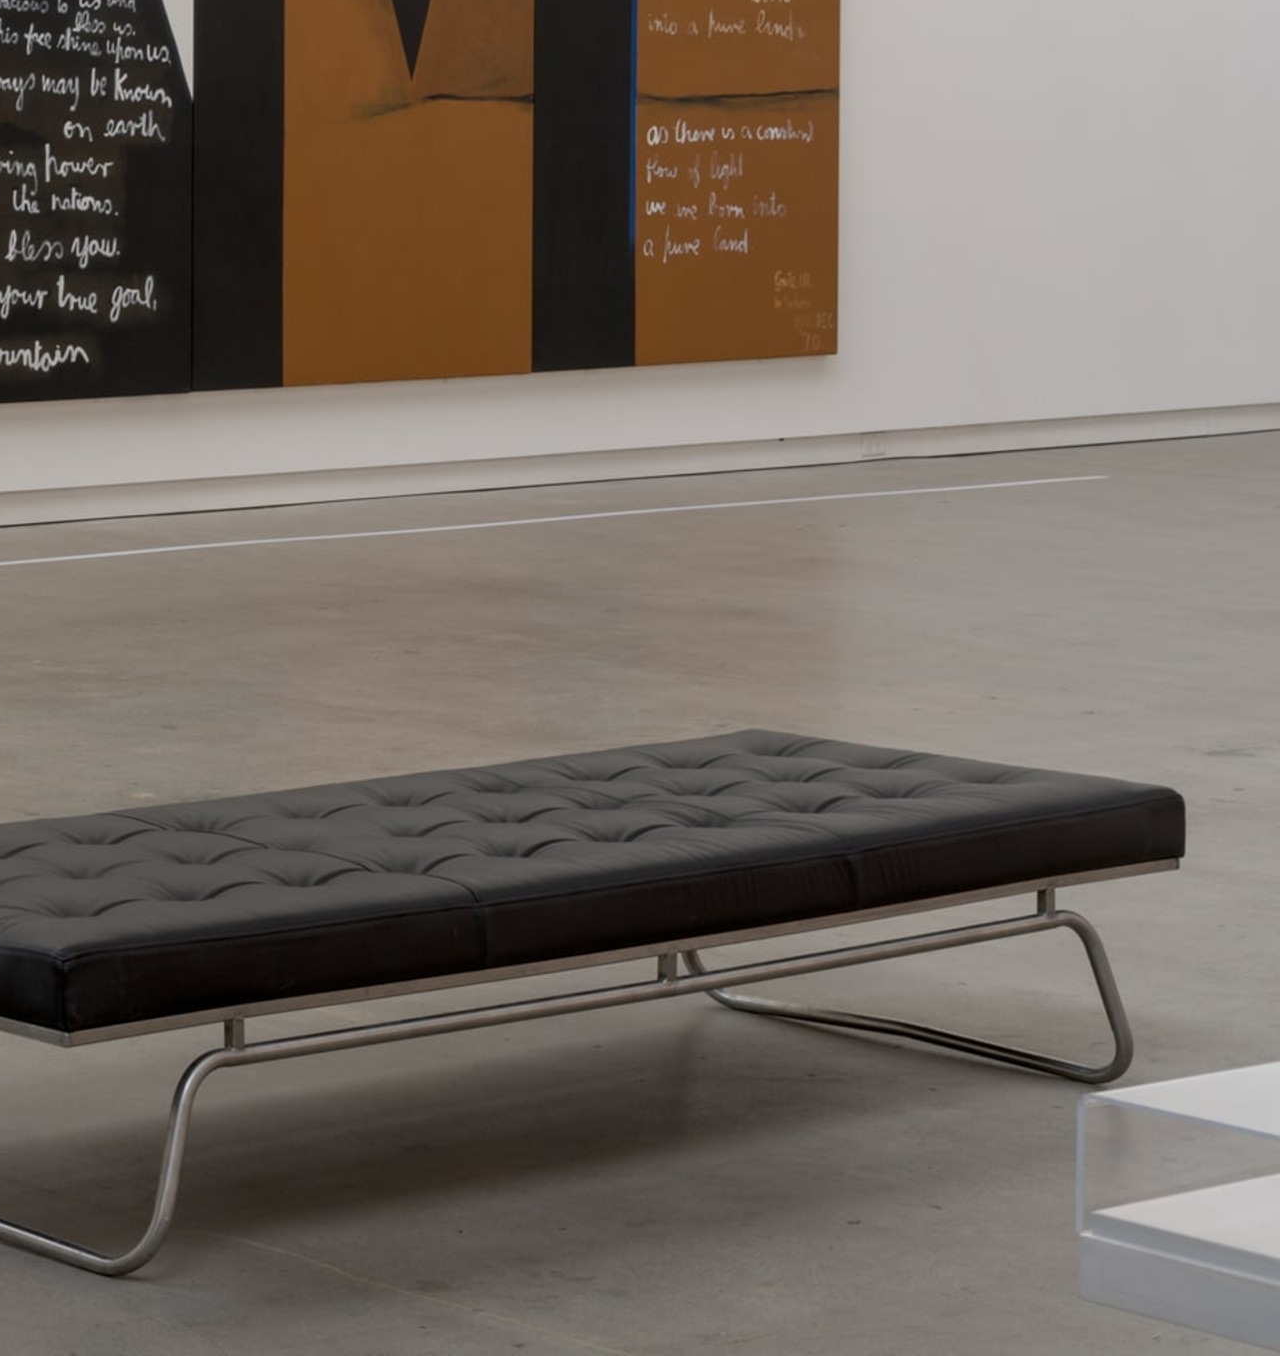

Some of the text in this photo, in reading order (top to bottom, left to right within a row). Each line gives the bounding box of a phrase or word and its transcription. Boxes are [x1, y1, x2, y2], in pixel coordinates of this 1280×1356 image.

[73, 10, 106, 34] bless
[23, 23, 51, 55] face
[106, 36, 145, 65] upon
[42, 73, 80, 112] may
[90, 67, 107, 97] be
[63, 109, 167, 142] on earth
[44, 142, 115, 182] power
[12, 183, 40, 214] the
[4, 229, 64, 262] bless
[57, 274, 98, 313] true
